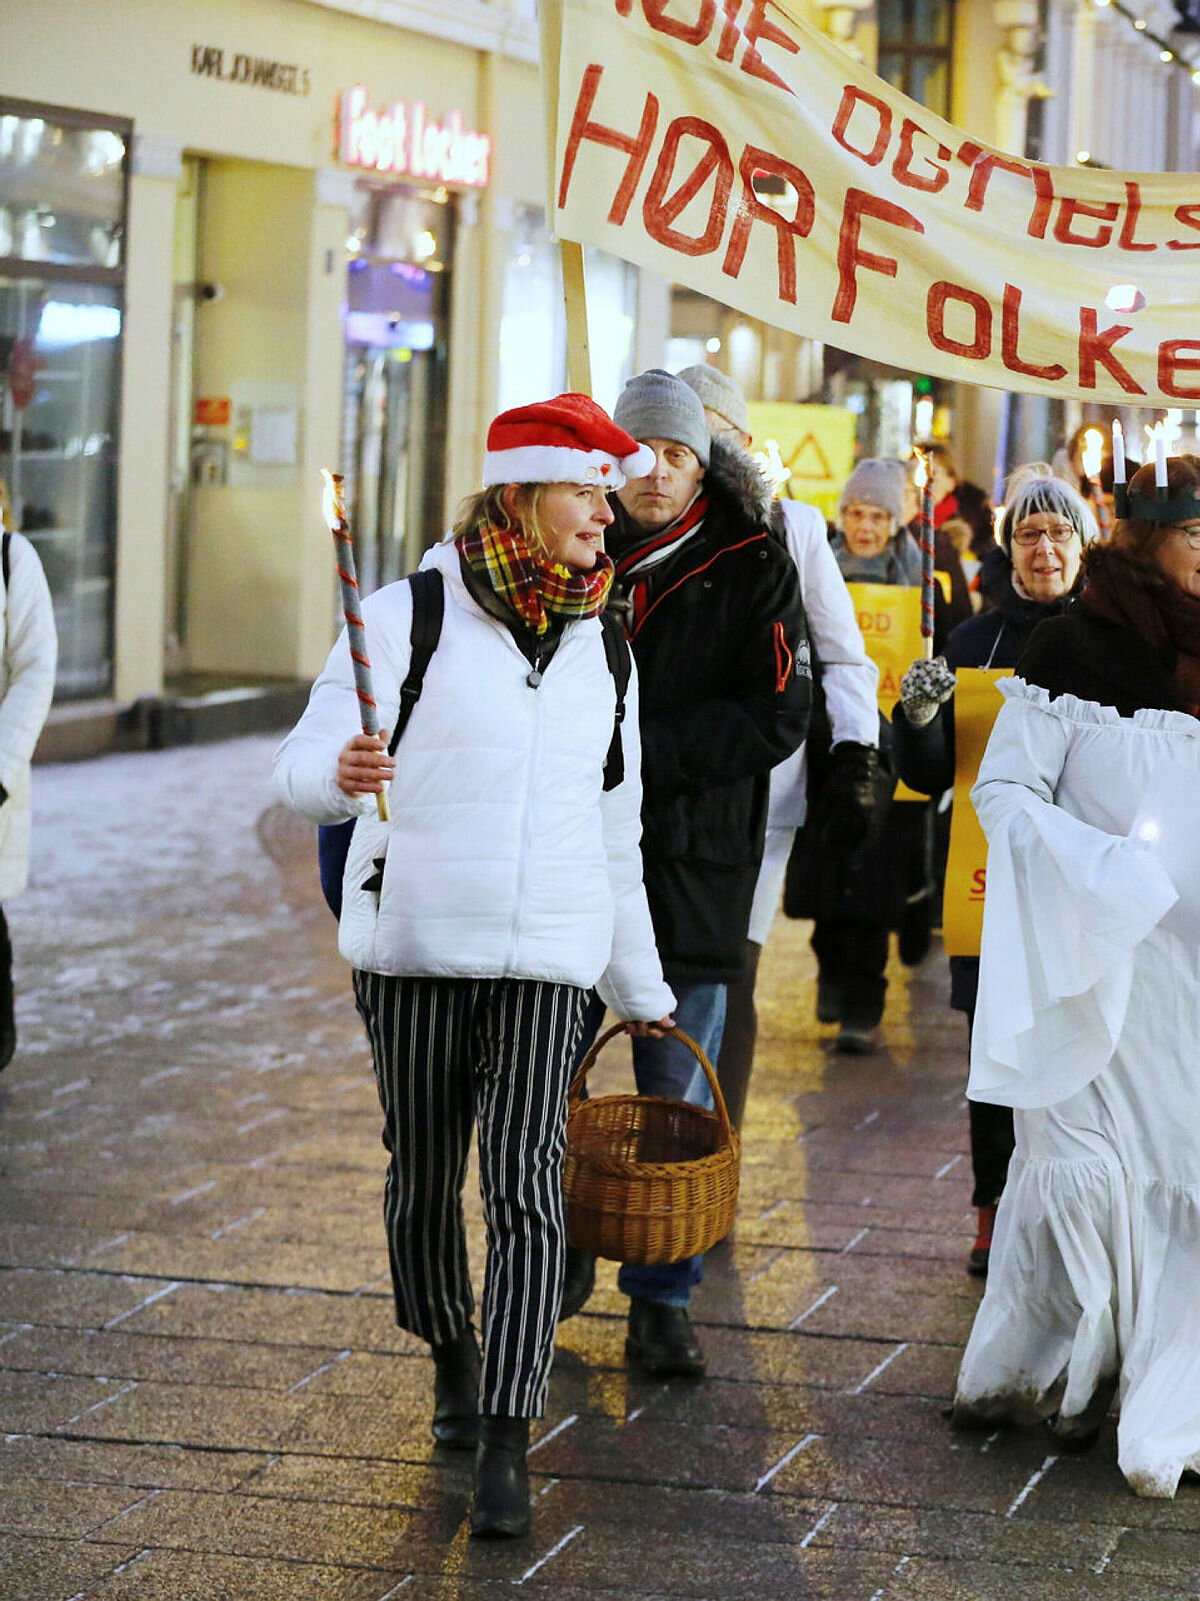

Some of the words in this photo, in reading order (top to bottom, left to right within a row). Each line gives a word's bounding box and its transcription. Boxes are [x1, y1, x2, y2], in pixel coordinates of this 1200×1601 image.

[346, 85, 407, 175] Foot
[408, 99, 492, 187] Locker
[558, 63, 815, 305] HØR
[857, 611, 892, 633] DD
